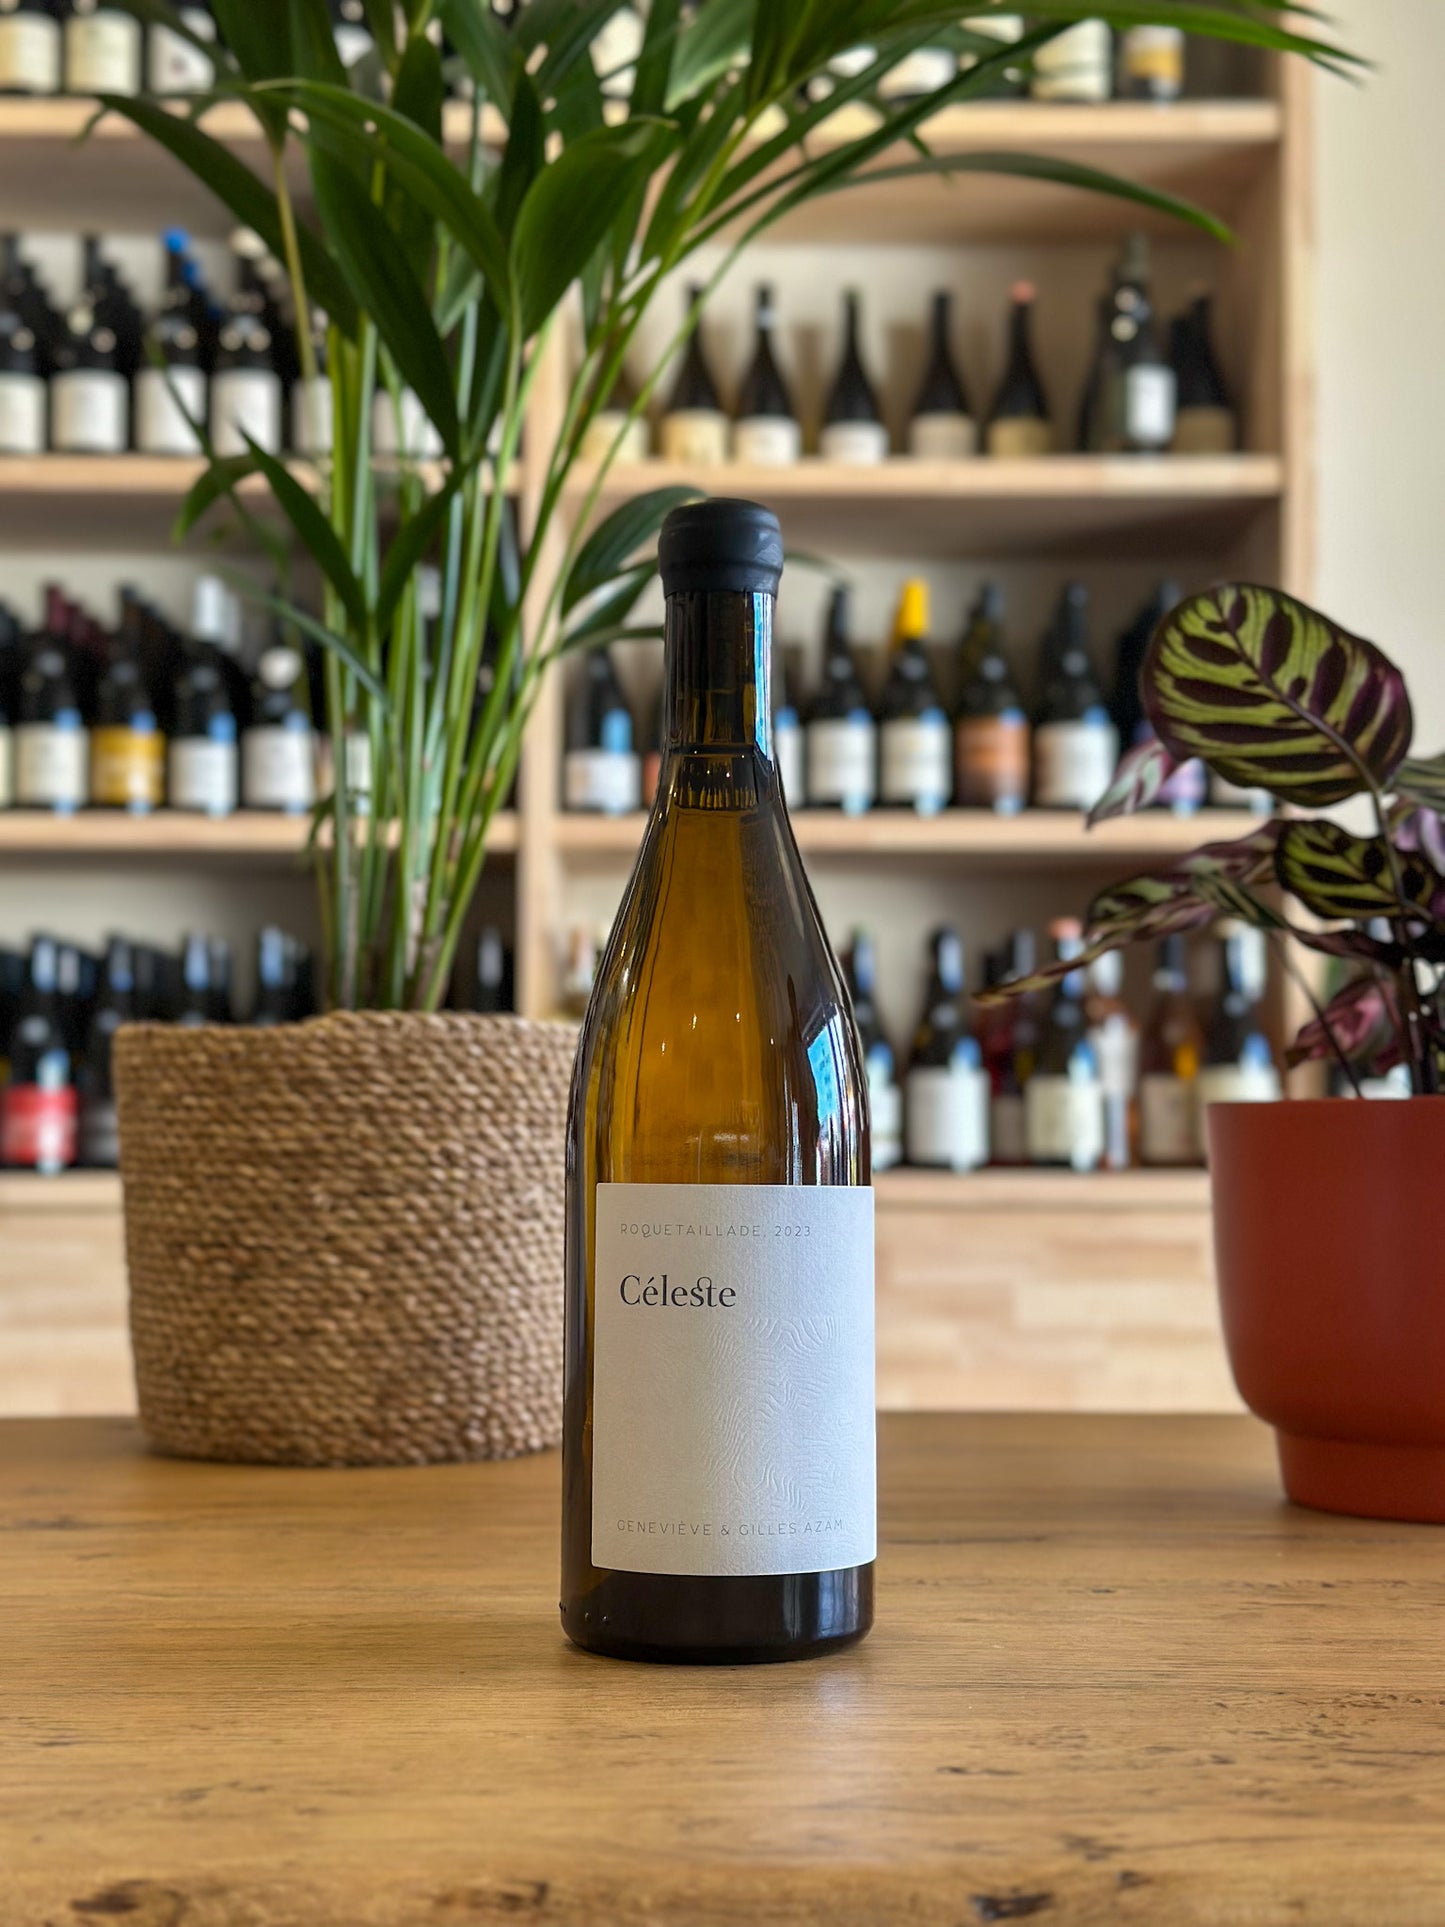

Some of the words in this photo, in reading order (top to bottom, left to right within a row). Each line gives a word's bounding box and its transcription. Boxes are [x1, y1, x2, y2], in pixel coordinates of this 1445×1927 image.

[774, 1225, 812, 1238] 2023
[619, 1274, 737, 1308] Céleste
[616, 1519, 713, 1537] GENEVIÈVE
[720, 1524, 730, 1537] &
[738, 1521, 797, 1537] GILLES
[803, 1518, 844, 1534] AZAM
